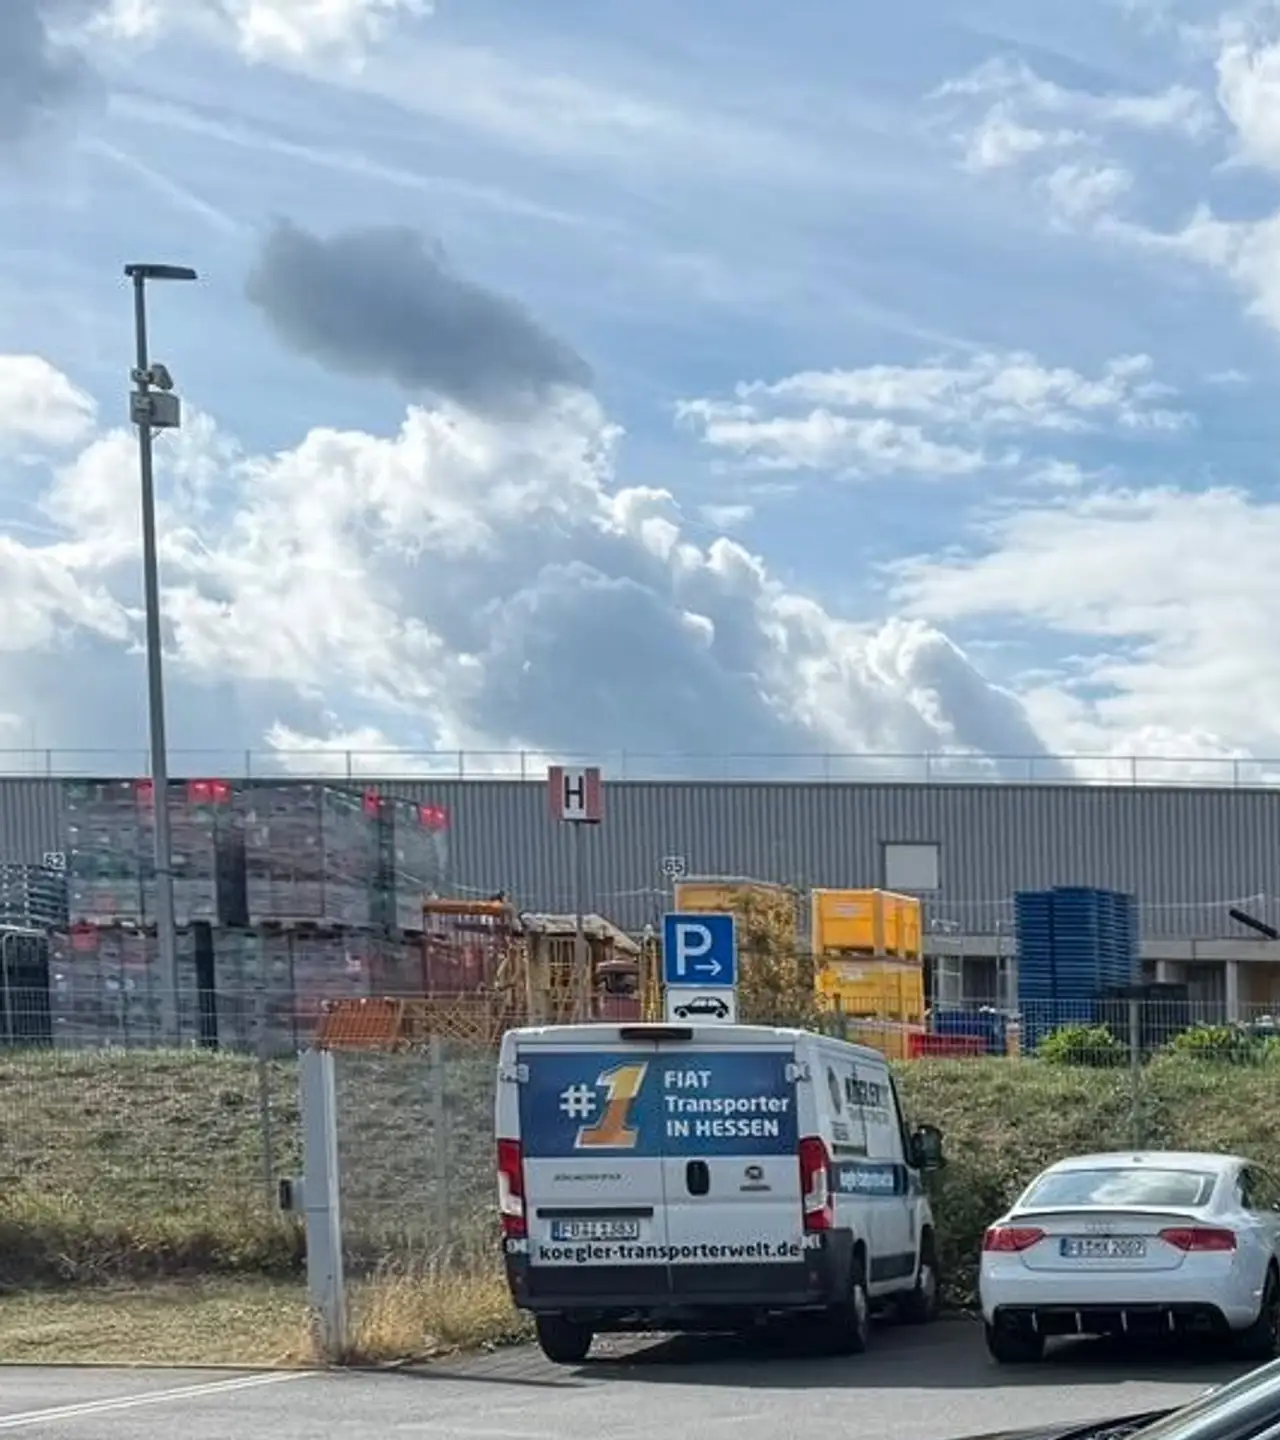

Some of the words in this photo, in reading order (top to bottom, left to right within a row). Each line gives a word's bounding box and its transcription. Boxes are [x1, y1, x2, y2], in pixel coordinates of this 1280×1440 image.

[564, 775, 584, 809] H
[664, 860, 683, 873] 65
[676, 924, 712, 975] P
[664, 1070, 712, 1089] FIAT
[665, 1096, 789, 1115] Transporter
[667, 1119, 689, 1137] IN
[696, 1119, 779, 1137] HESSEN
[540, 1241, 799, 1262] koegler-transporterwelt.de
